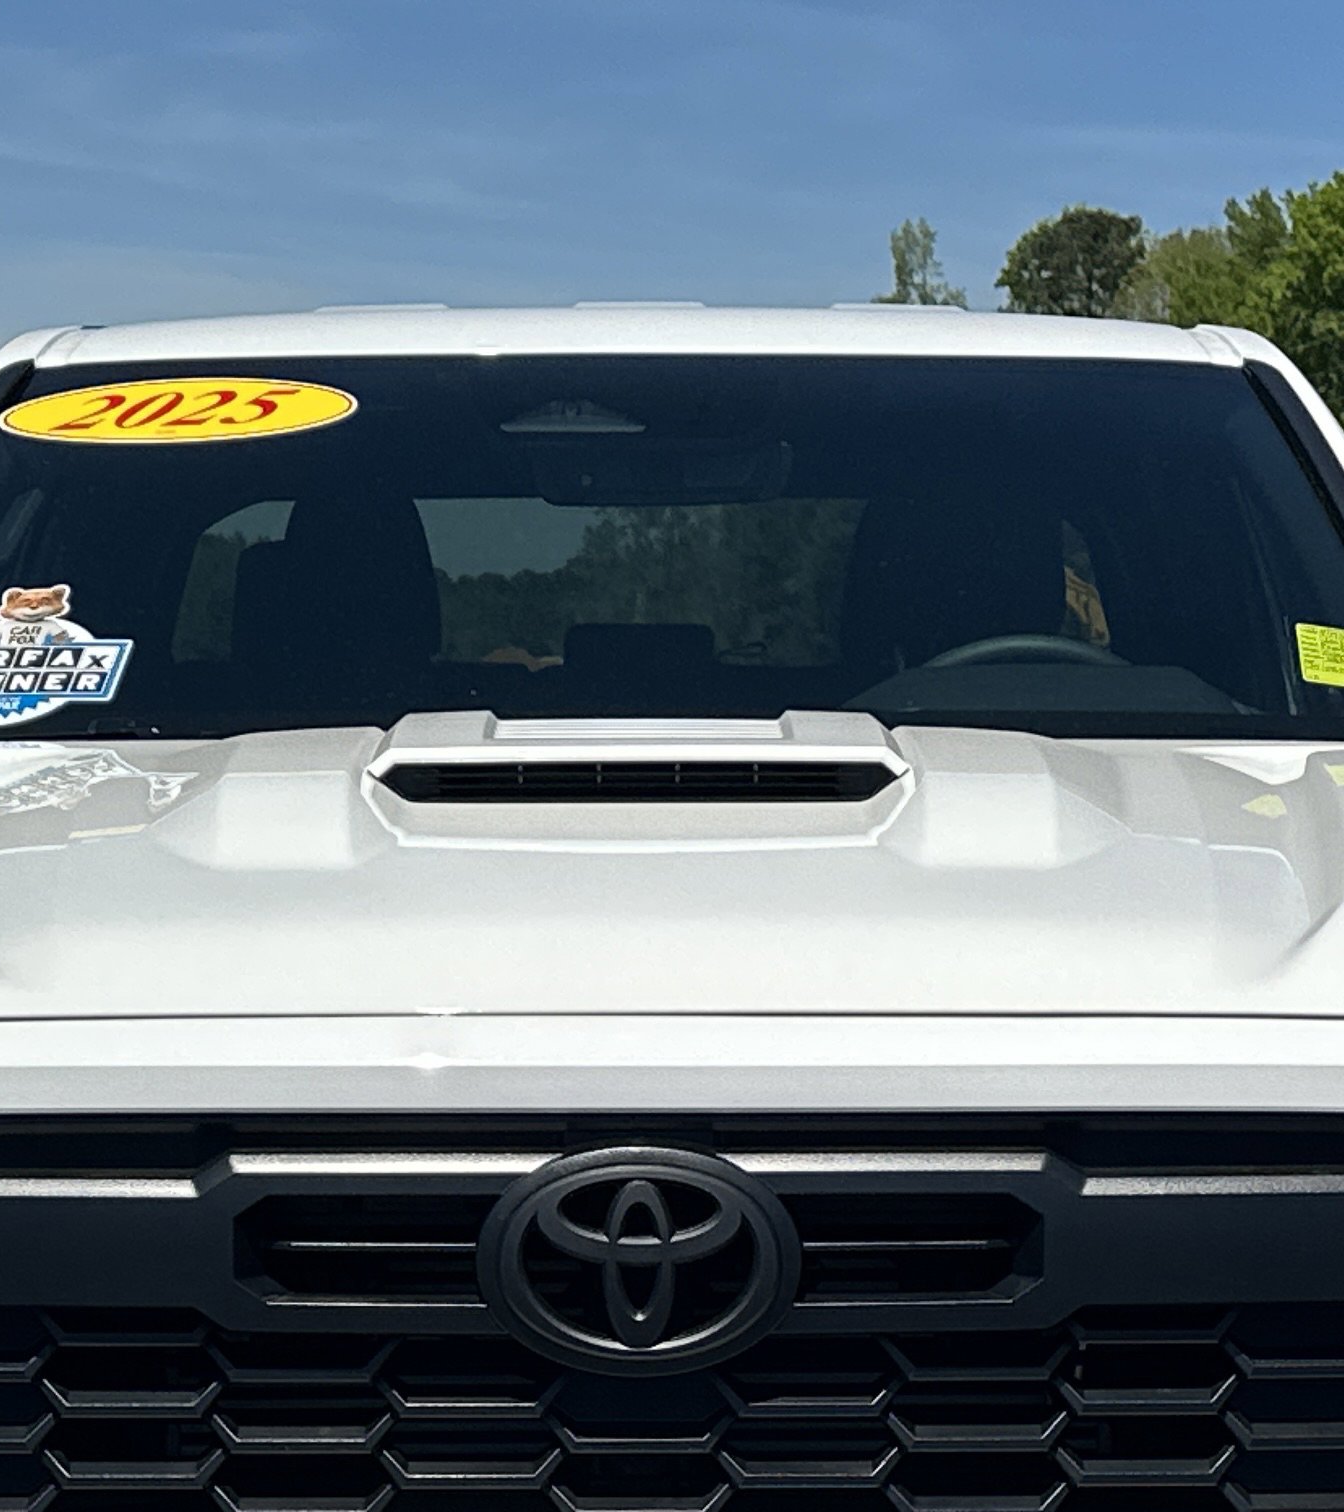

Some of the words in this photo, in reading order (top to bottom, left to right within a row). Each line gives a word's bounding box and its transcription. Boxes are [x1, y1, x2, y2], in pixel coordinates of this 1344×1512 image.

[47, 388, 301, 433] 2025
[9, 625, 42, 635] CAR
[8, 634, 36, 645] FOX
